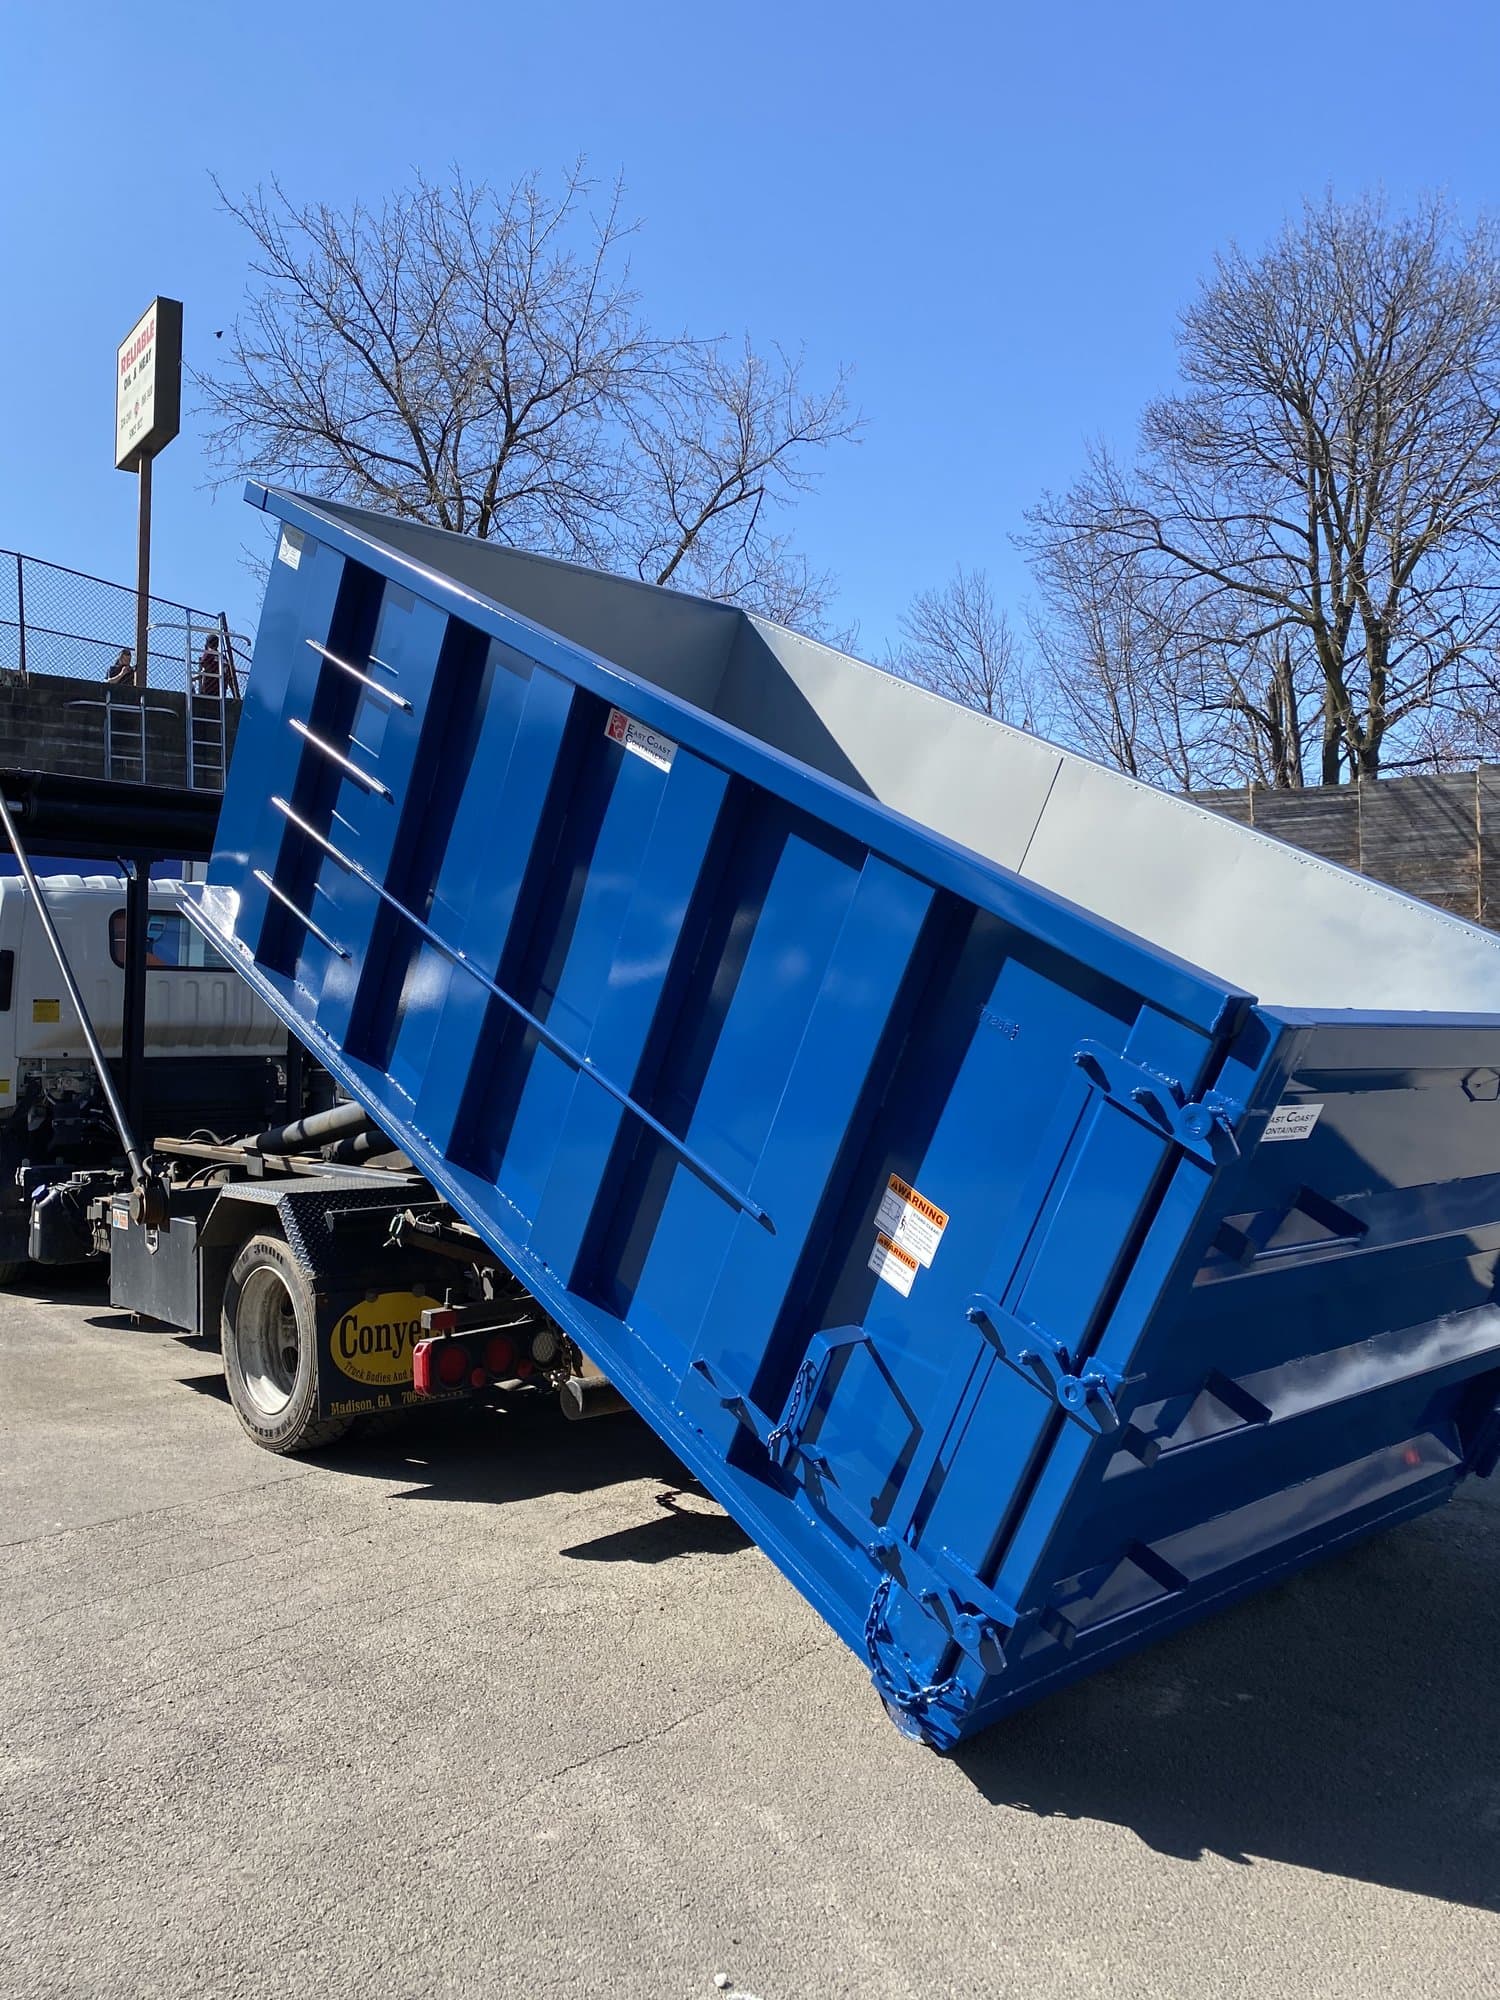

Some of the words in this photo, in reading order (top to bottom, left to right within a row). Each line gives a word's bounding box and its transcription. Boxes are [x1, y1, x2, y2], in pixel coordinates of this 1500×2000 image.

[121, 319, 155, 376] RELIABLE
[139, 347, 152, 374] HEAT
[625, 733, 668, 763] CONTAINERS
[627, 723, 646, 741] EAST
[647, 735, 671, 756] COAST
[1265, 1125, 1309, 1135] ONTAINERS
[1286, 1111, 1315, 1123] COAST
[896, 1183, 943, 1226] WARNING
[882, 1240, 916, 1269] WARNING
[339, 1314, 443, 1359] Conye
[344, 1361, 364, 1379] Truck
[367, 1370, 391, 1383] Bodies
[394, 1369, 408, 1381] And
[330, 1398, 375, 1416] Madison,
[378, 1393, 391, 1408] GA
